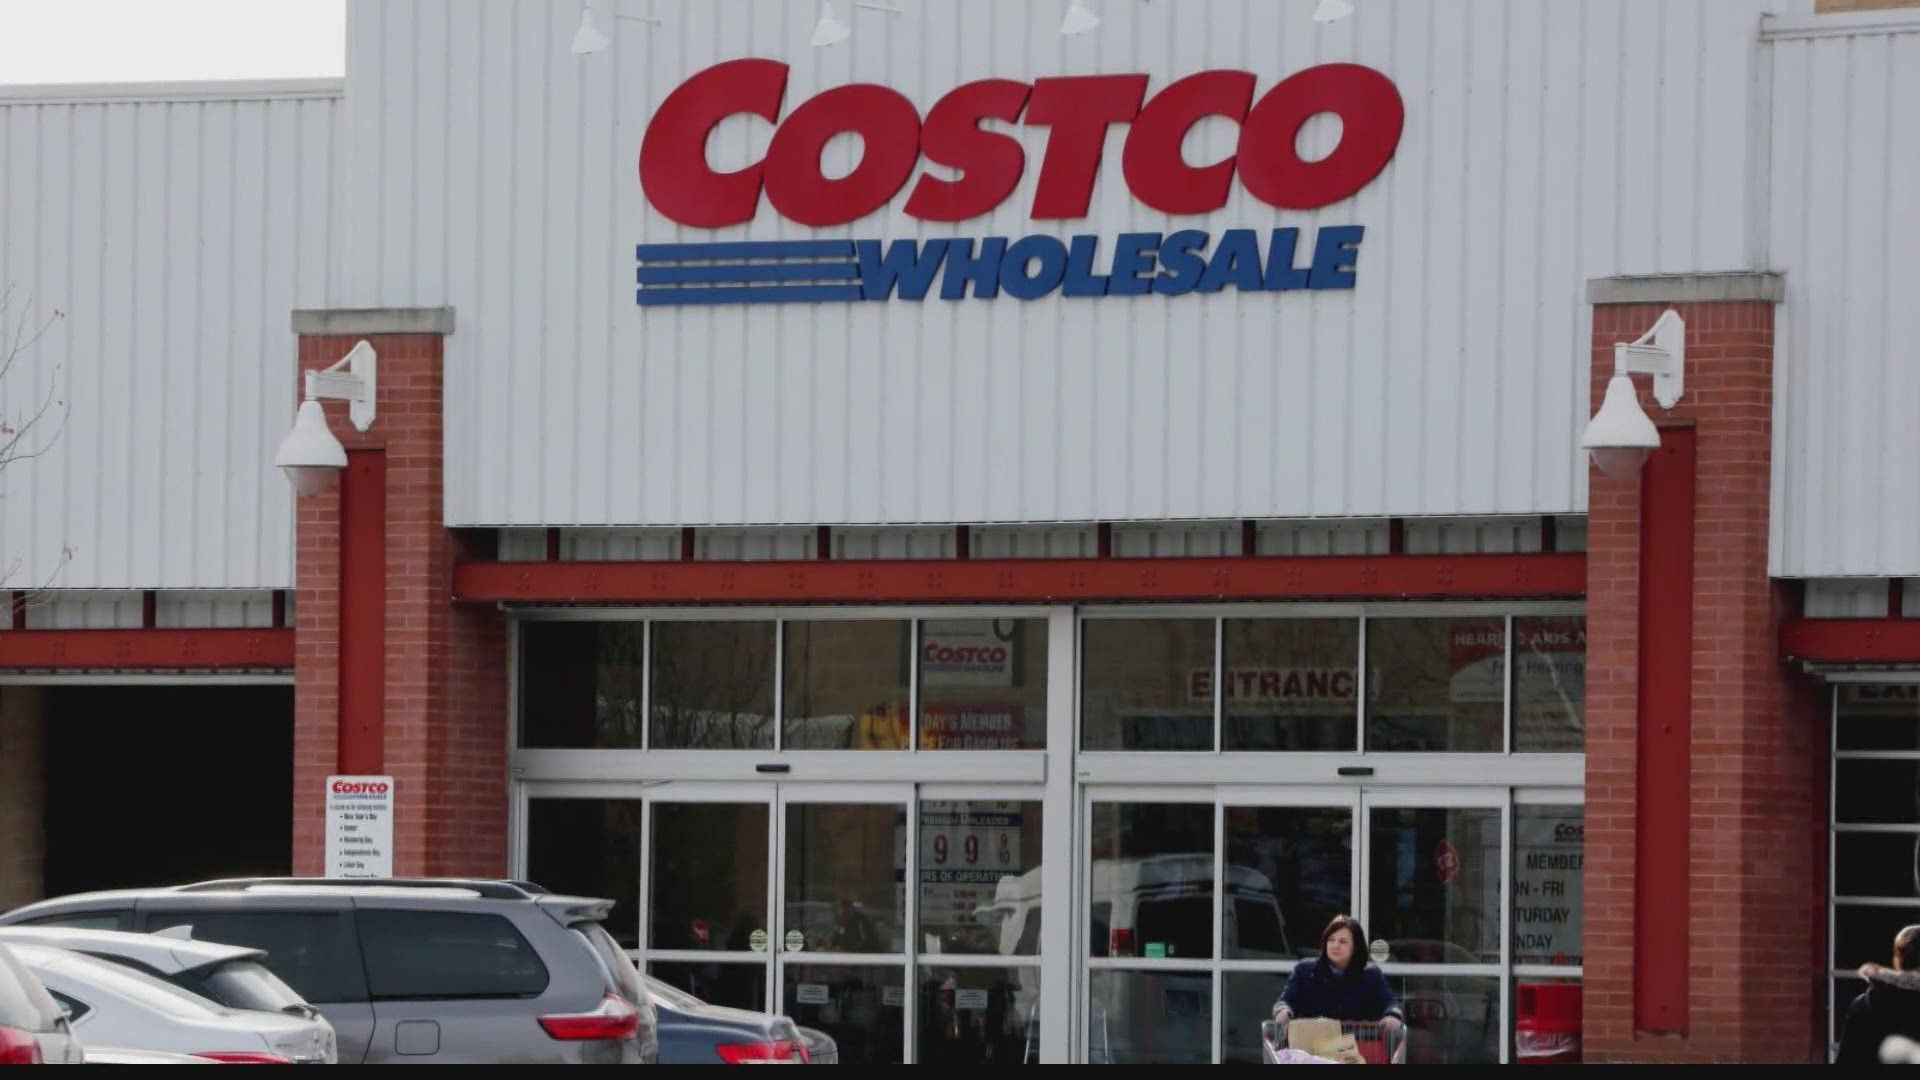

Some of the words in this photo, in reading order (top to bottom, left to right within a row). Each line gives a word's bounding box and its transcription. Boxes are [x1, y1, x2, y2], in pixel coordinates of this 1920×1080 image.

[639, 57, 1405, 228] COSTCO
[856, 225, 1365, 301] WHOLESALE
[925, 643, 1007, 663] COSTCO
[1191, 671, 1376, 698] ETRANC
[332, 781, 389, 794] COSTCO
[934, 834, 948, 864] 9
[1543, 881, 1565, 896] FRI
[1497, 907, 1571, 923] TURDAY
[1497, 934, 1553, 949] NDAY
